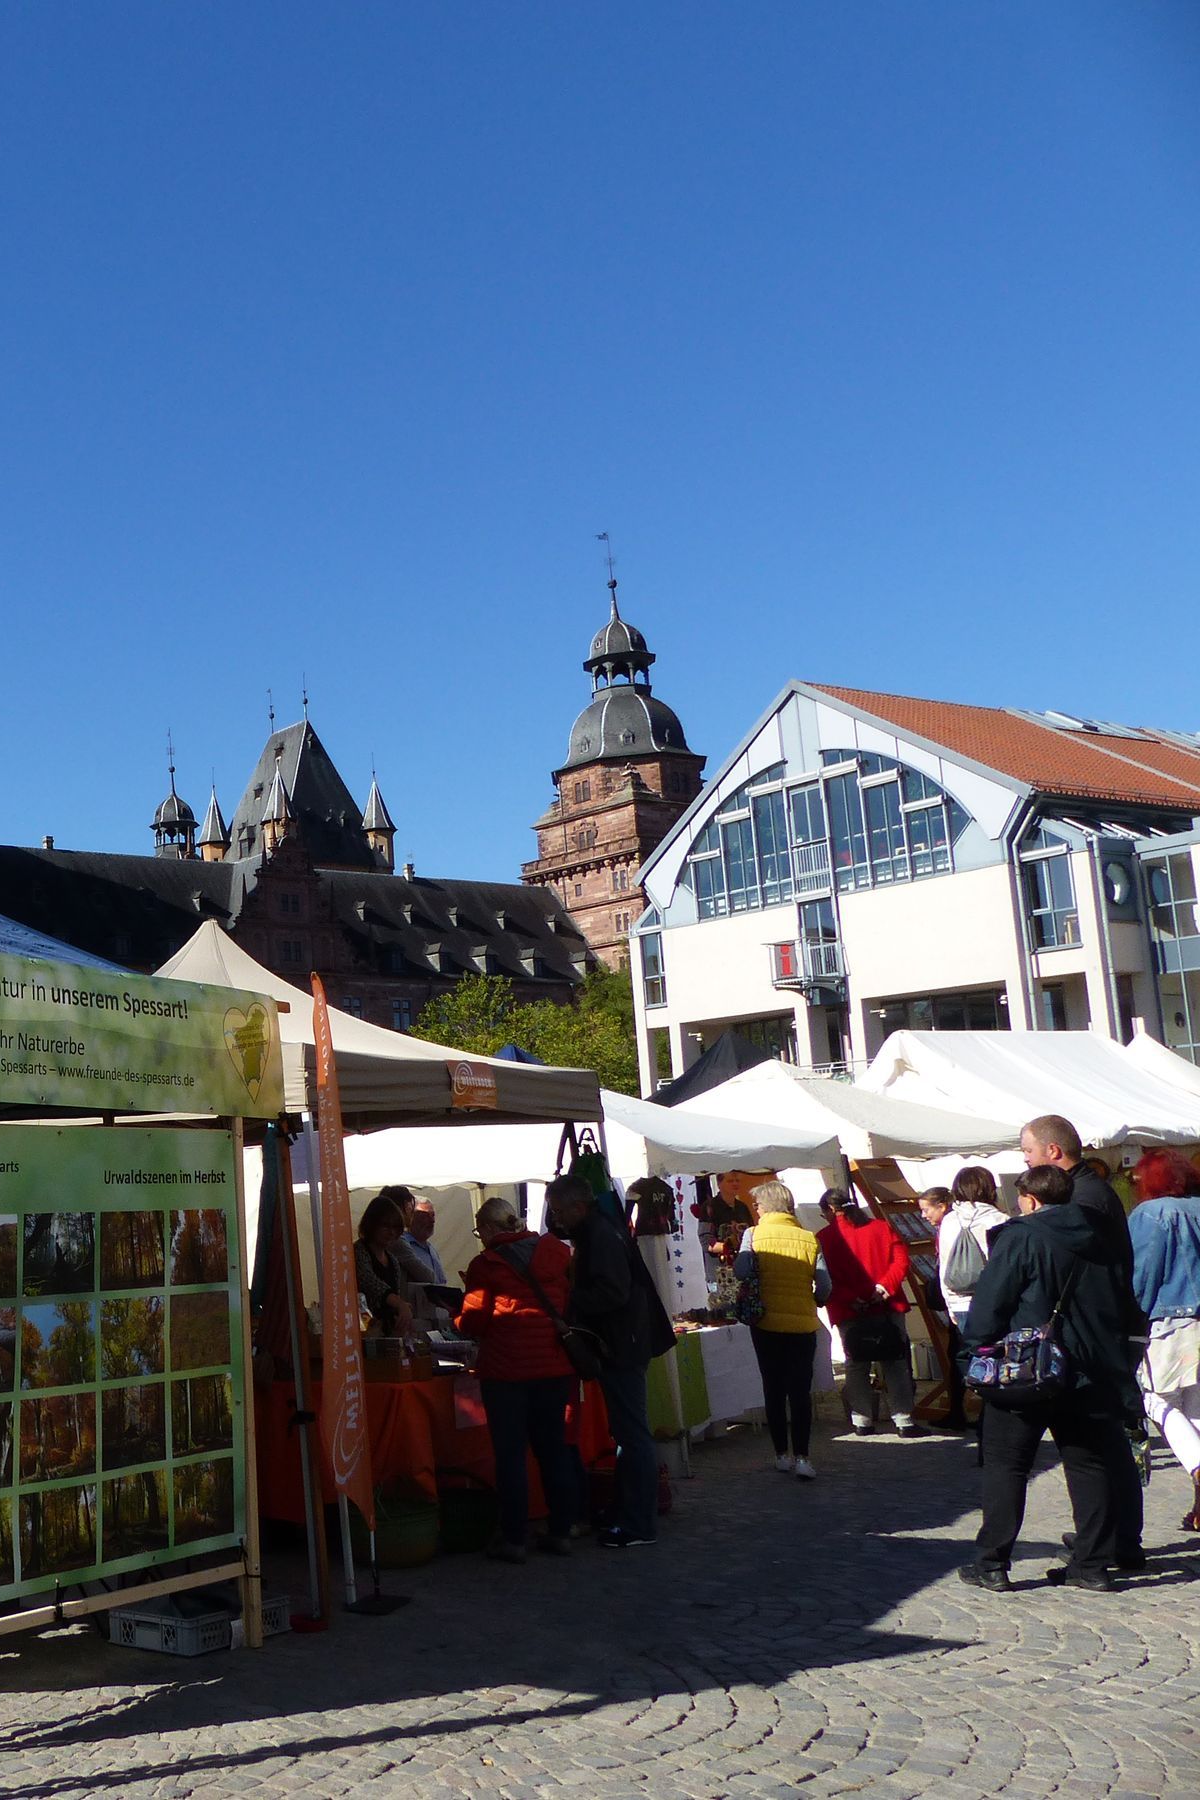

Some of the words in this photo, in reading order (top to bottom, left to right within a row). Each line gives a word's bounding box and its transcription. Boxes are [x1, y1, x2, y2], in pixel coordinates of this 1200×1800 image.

[32, 979, 46, 1002] in
[51, 986, 119, 1011] unserem
[123, 992, 189, 1020] Spessart!
[18, 1032, 85, 1056] Naturerbe
[0, 1058, 47, 1078] Spessarts
[58, 1065, 195, 1087] www.freunde-des-spessarts.de
[104, 1169, 178, 1185] Urwaldszenen
[179, 1170, 191, 1184] im
[194, 1169, 226, 1184] Herbst
